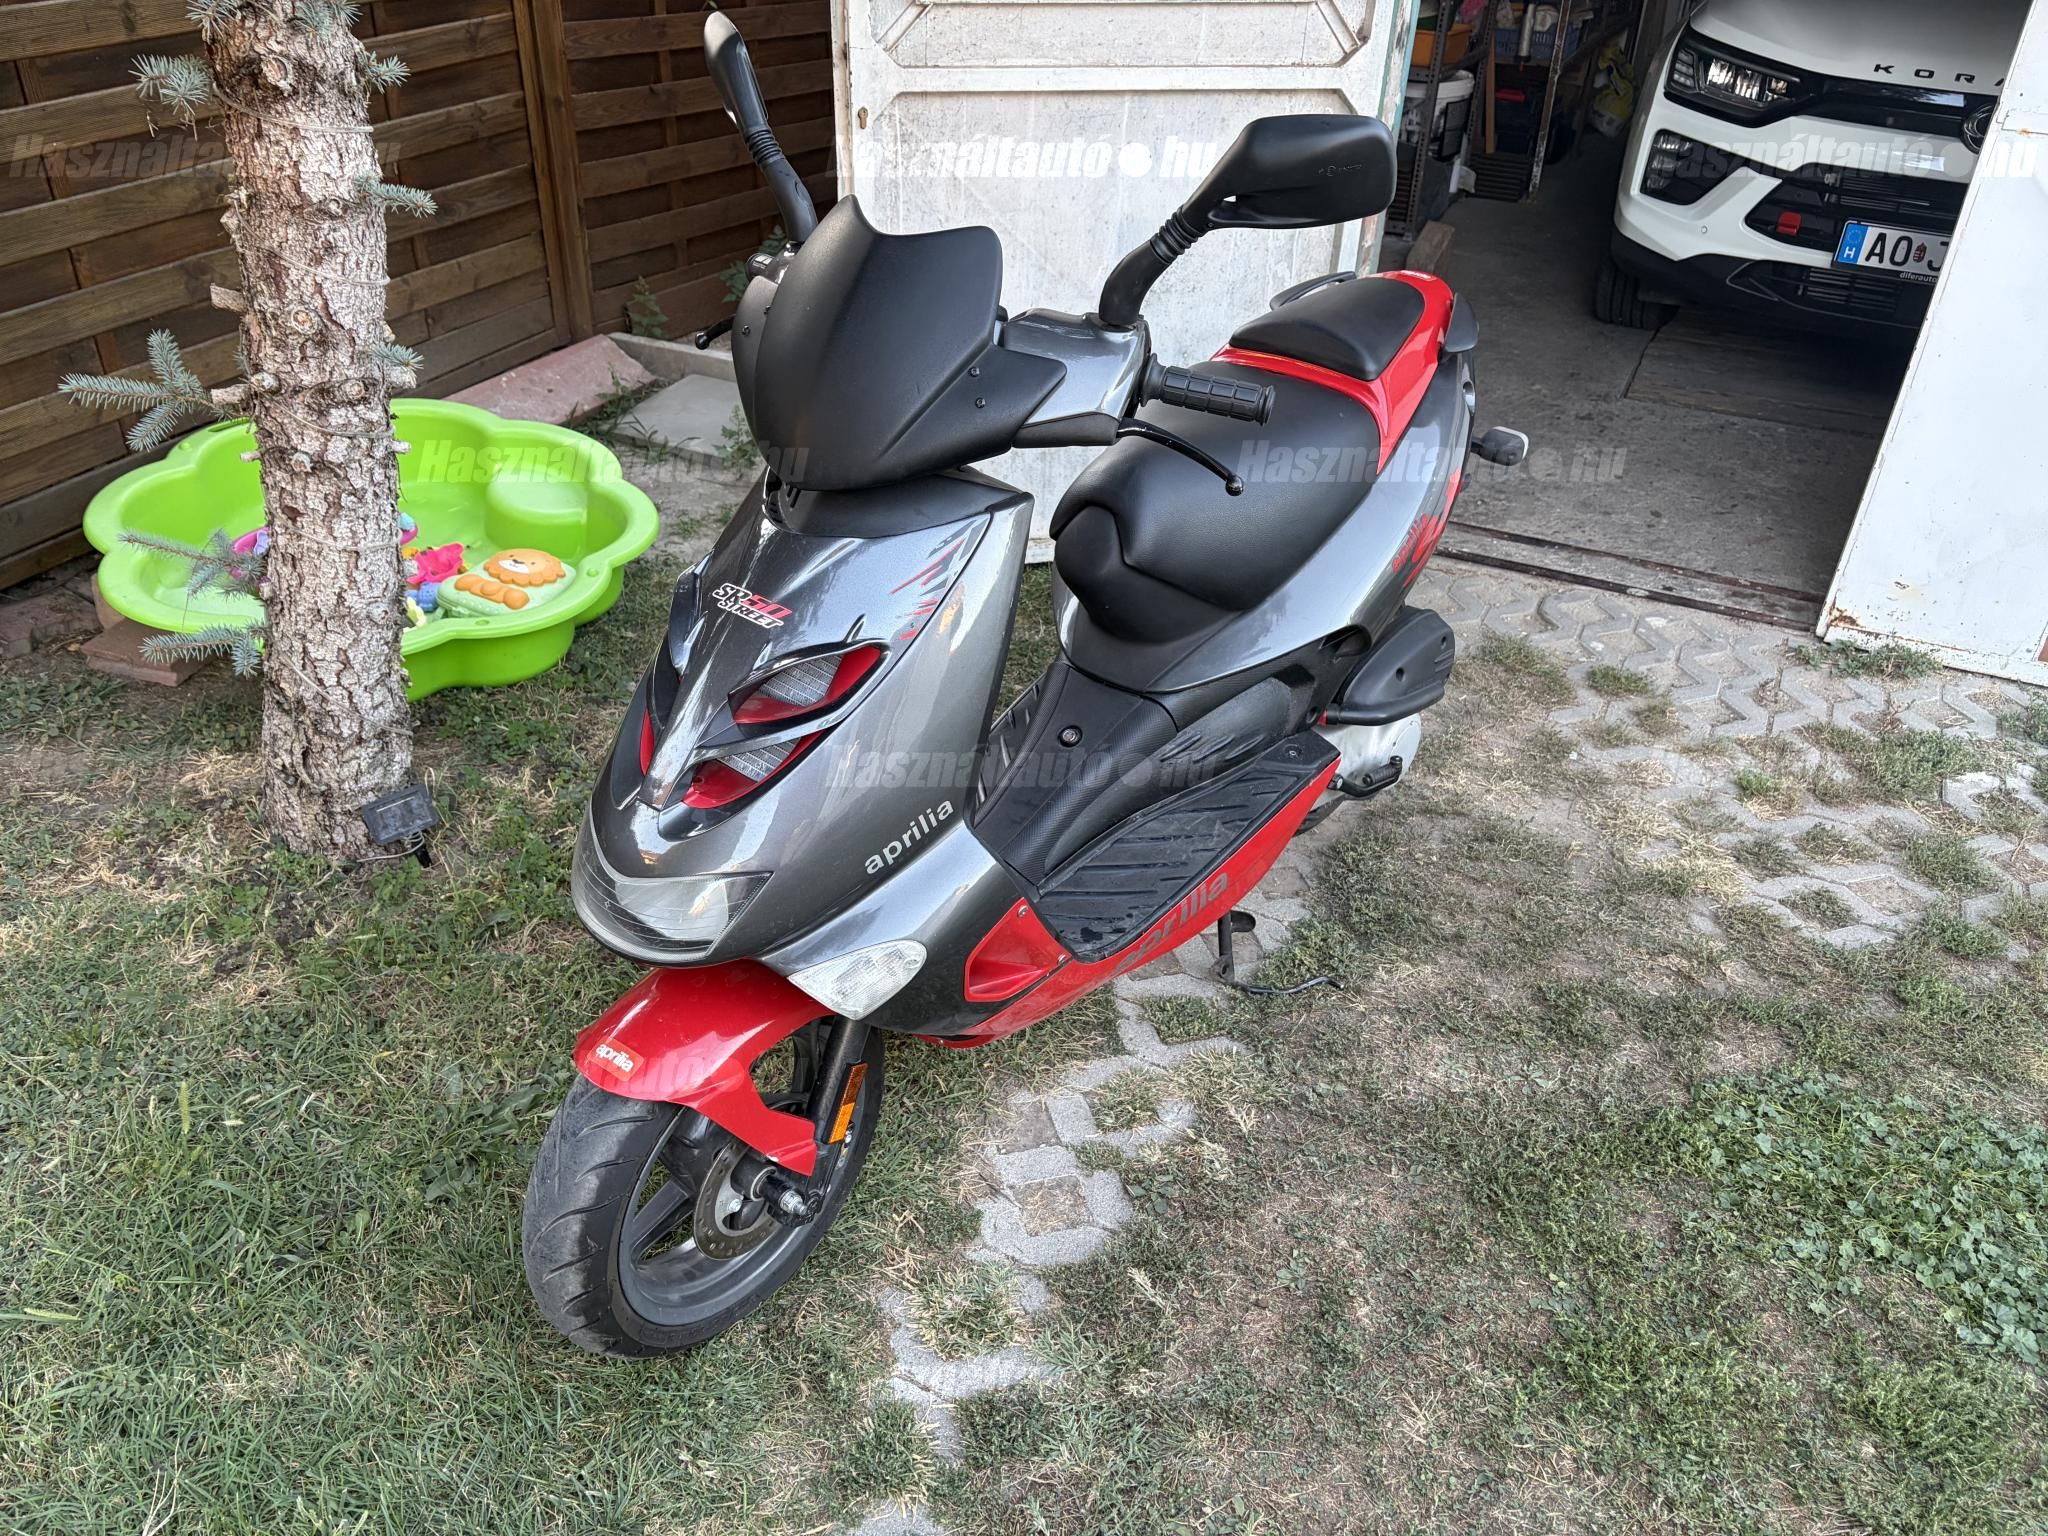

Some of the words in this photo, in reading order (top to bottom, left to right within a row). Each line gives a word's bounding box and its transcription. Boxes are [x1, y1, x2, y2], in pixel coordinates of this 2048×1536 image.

[1843, 247, 1856, 259] H
[717, 600, 784, 629] STREET
[864, 800, 954, 874] aprilia
[1112, 872, 1228, 977] aprilia
[595, 1043, 634, 1073] aprilia
